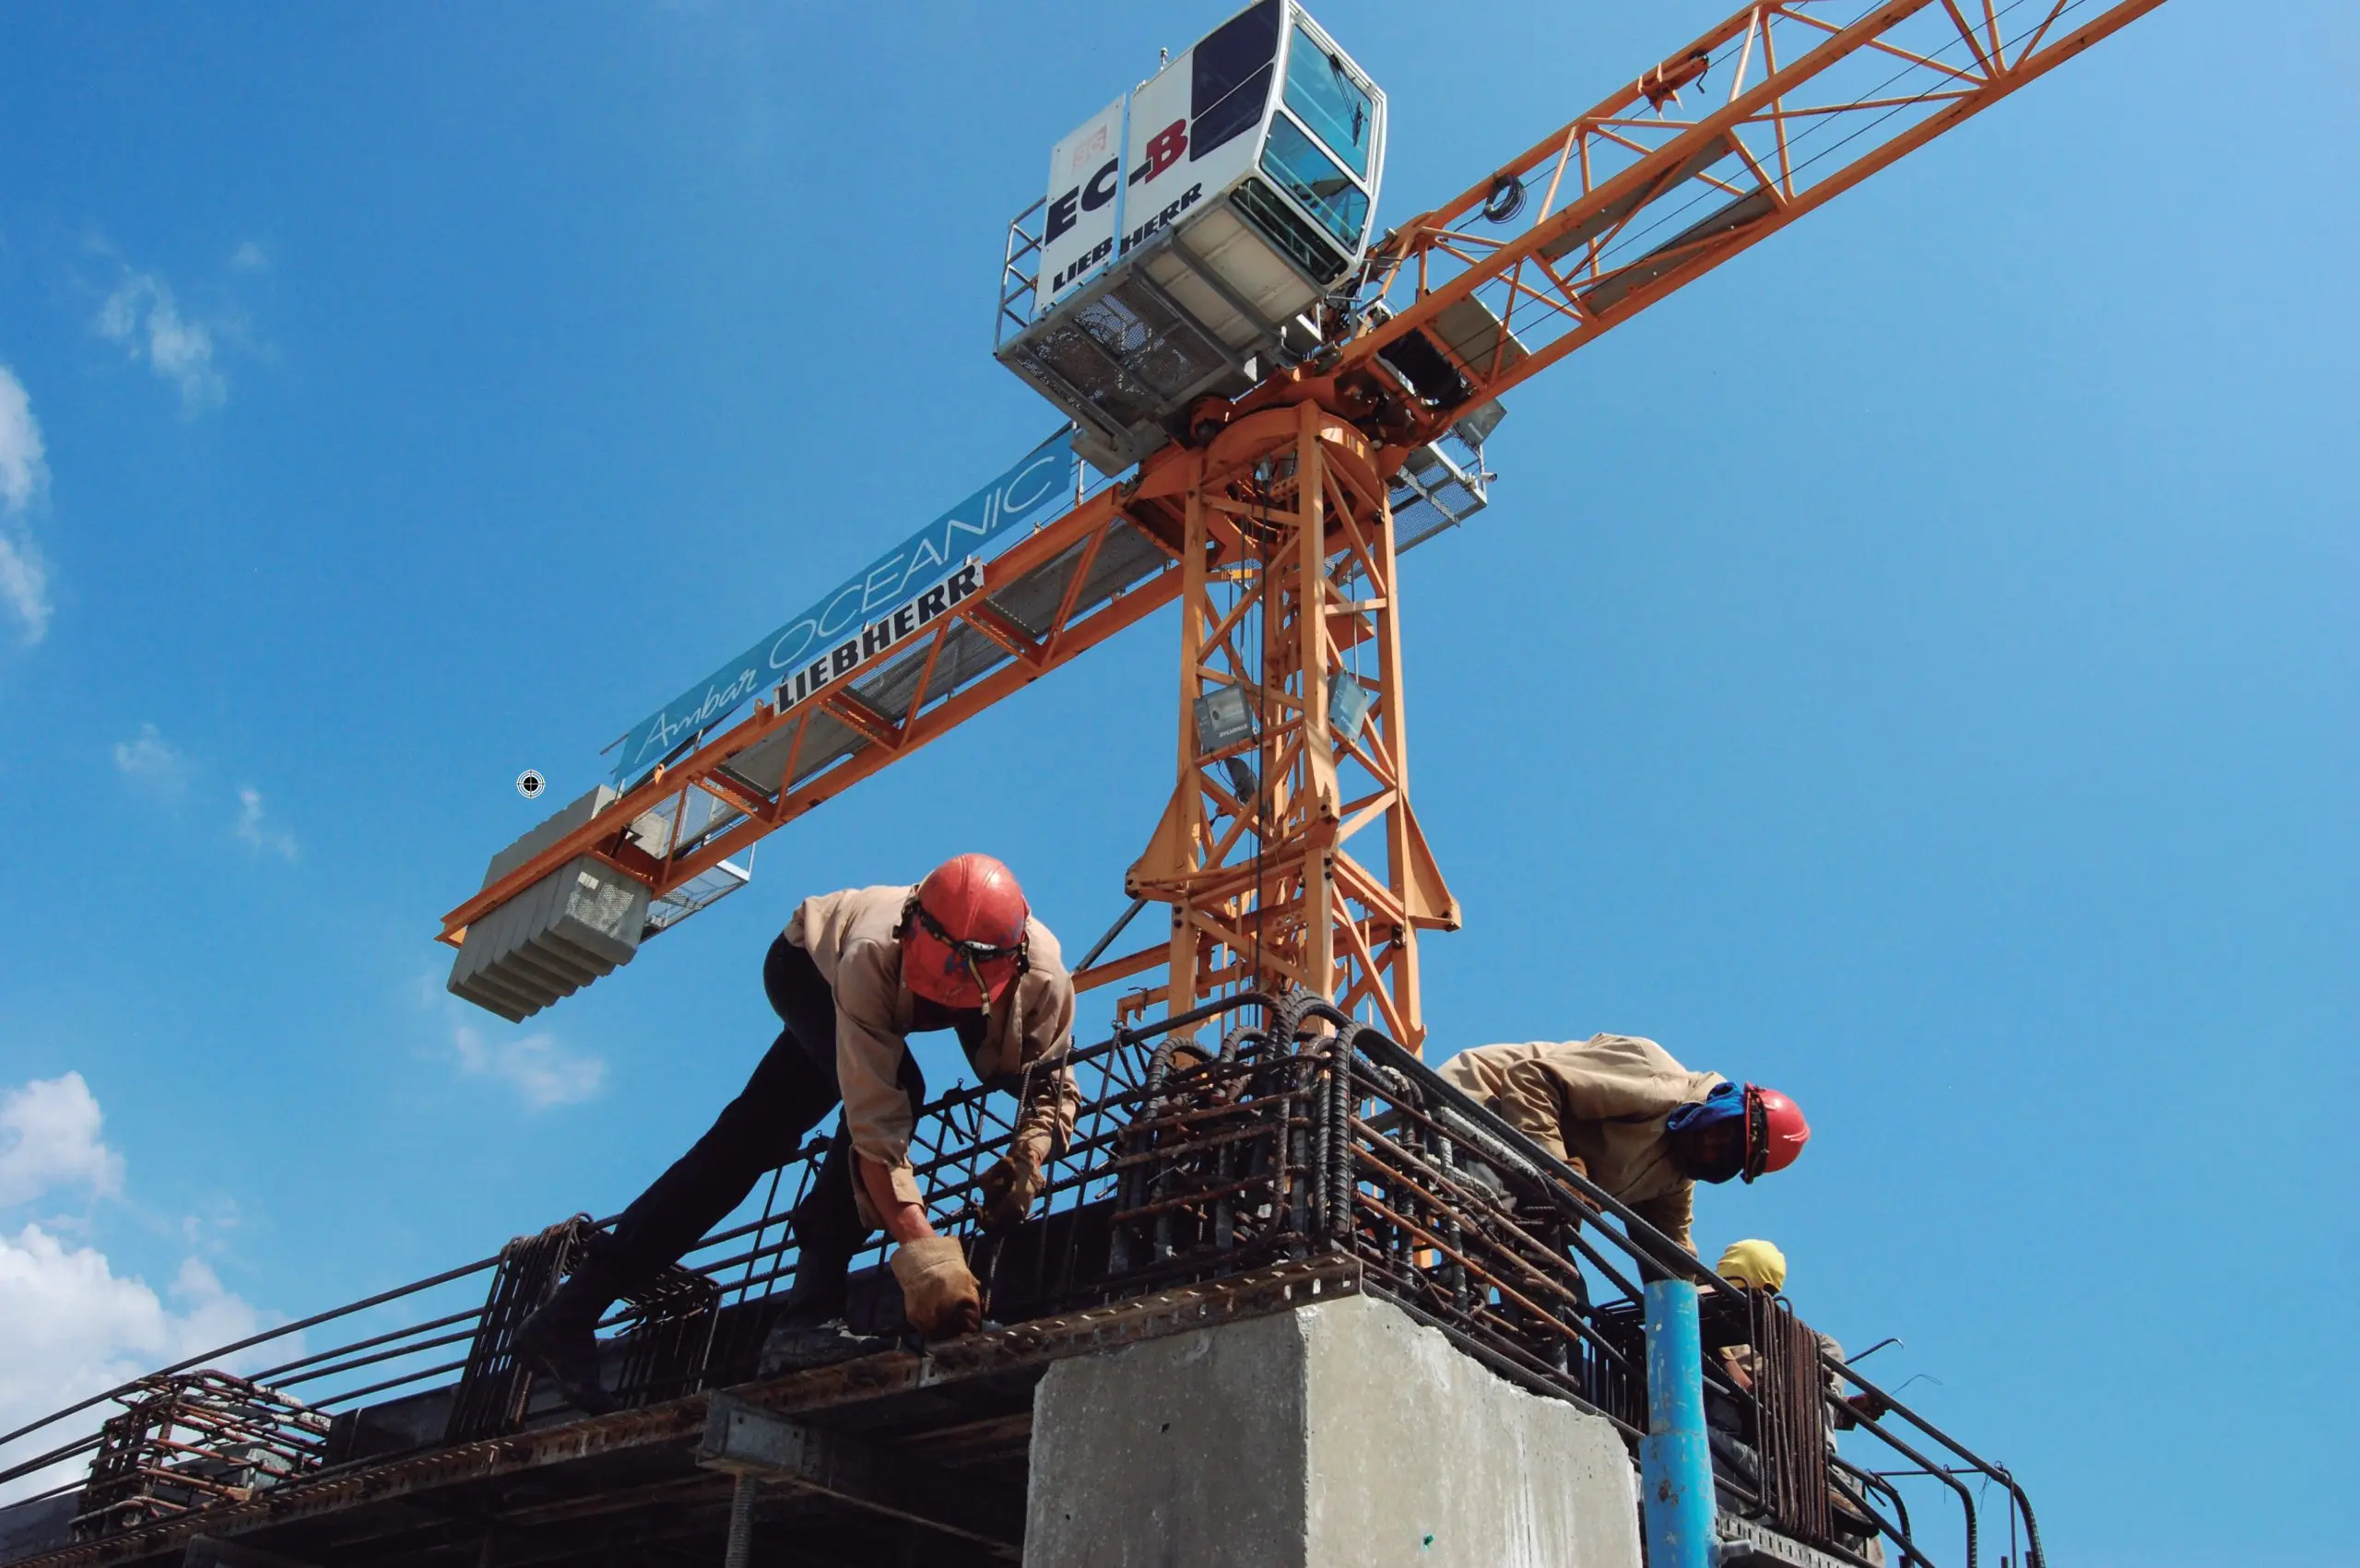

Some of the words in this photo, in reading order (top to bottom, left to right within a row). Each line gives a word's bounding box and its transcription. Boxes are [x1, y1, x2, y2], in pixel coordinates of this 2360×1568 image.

[634, 668, 758, 764] Ambar
[769, 455, 1056, 670] OCEANIC
[778, 563, 980, 713] LIEBHERR
